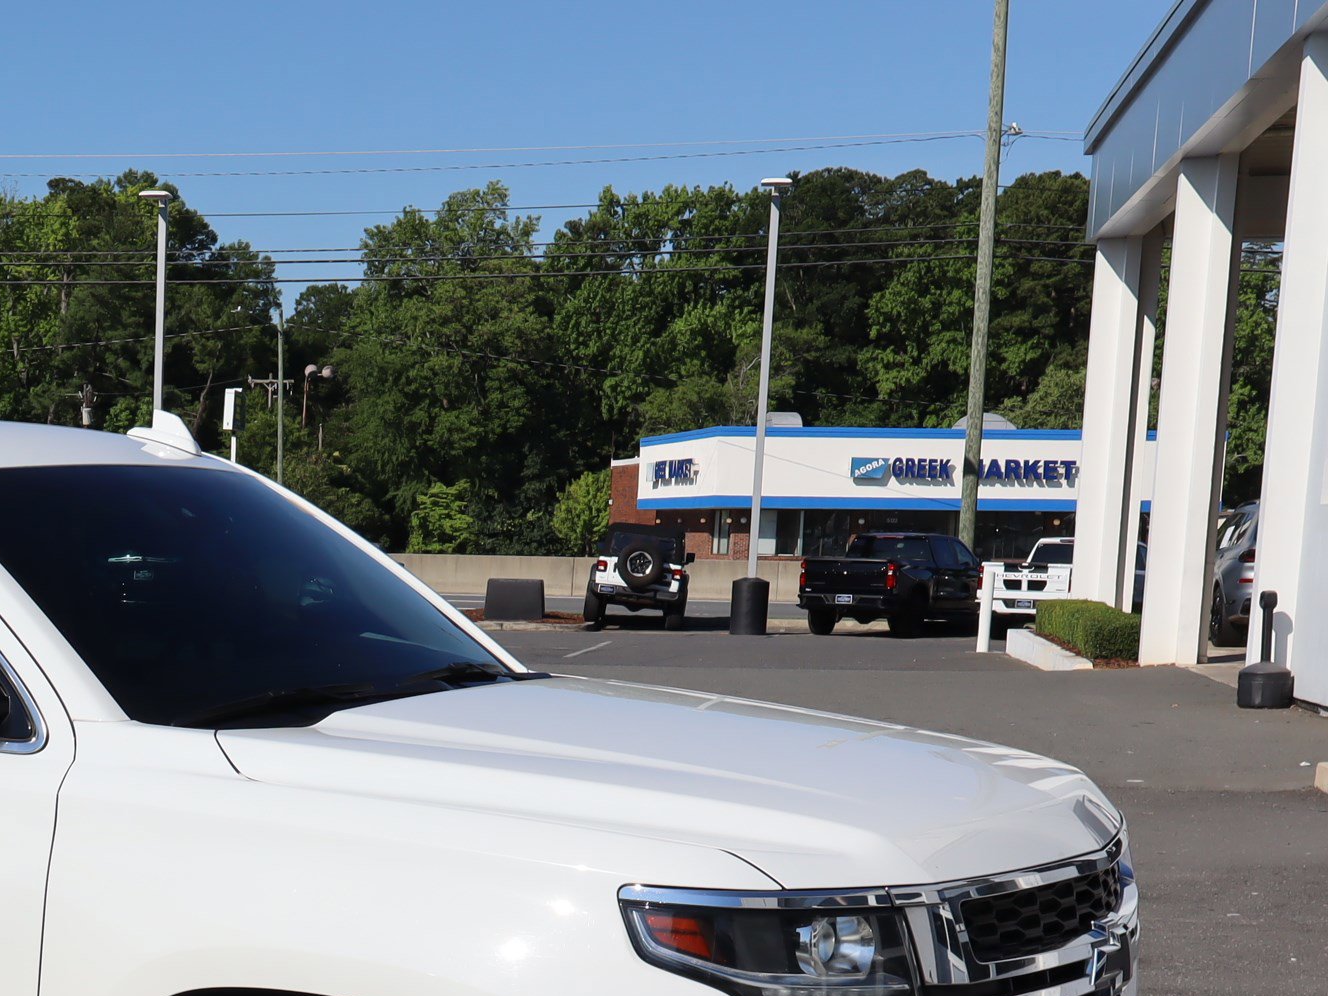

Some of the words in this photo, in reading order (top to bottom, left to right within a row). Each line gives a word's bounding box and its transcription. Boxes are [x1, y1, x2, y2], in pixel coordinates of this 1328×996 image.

[854, 458, 886, 477] AGORA
[892, 457, 951, 479] GREEK
[978, 458, 1077, 481] ARKET
